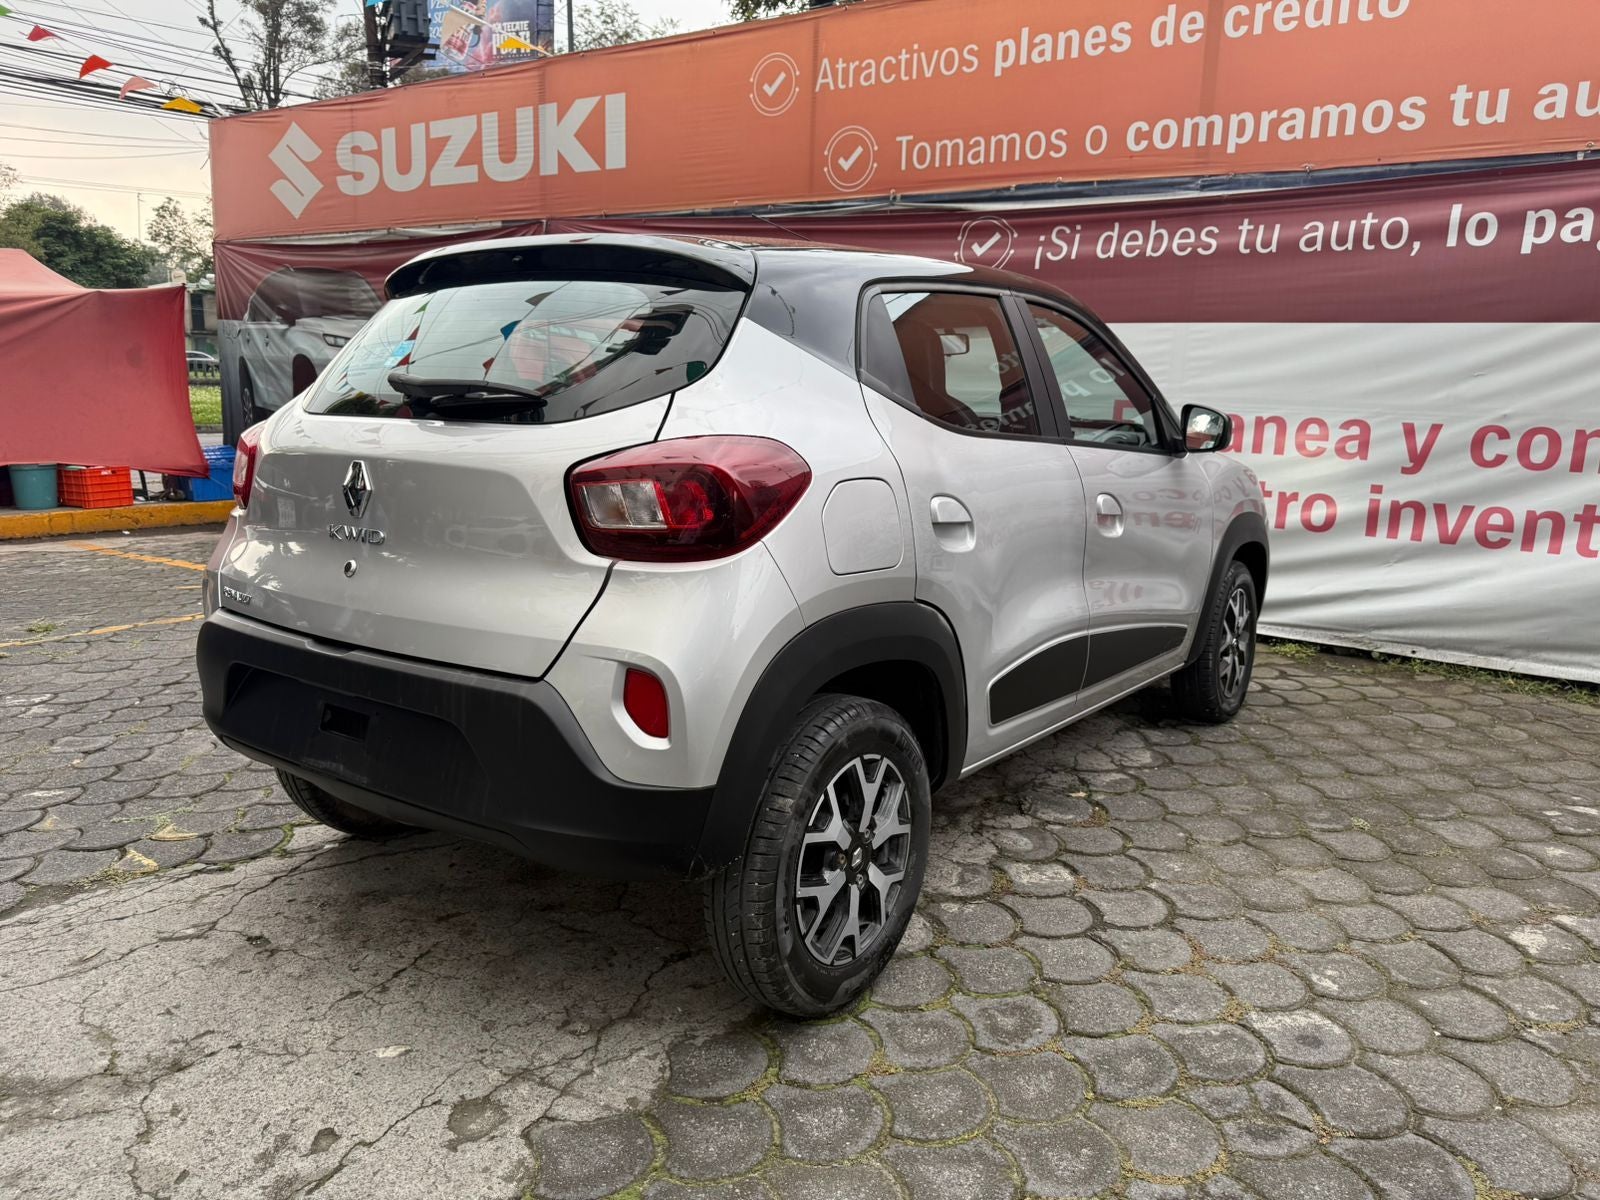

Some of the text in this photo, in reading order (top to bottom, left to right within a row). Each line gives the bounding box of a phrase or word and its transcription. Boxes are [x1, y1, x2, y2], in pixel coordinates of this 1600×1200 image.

[815, 44, 979, 92] Atractivos
[994, 22, 1132, 77] planes
[1150, 4, 1205, 47] de
[335, 92, 627, 196] SUZUKI
[896, 128, 1067, 171] Tomamos
[1085, 125, 1108, 155] o
[1126, 95, 1427, 154] compramos
[1449, 84, 1510, 127] tu
[1034, 203, 1600, 270] ¡Si debes tu auto, lo pa
[1402, 423, 1443, 475] y
[328, 523, 387, 546] KWID
